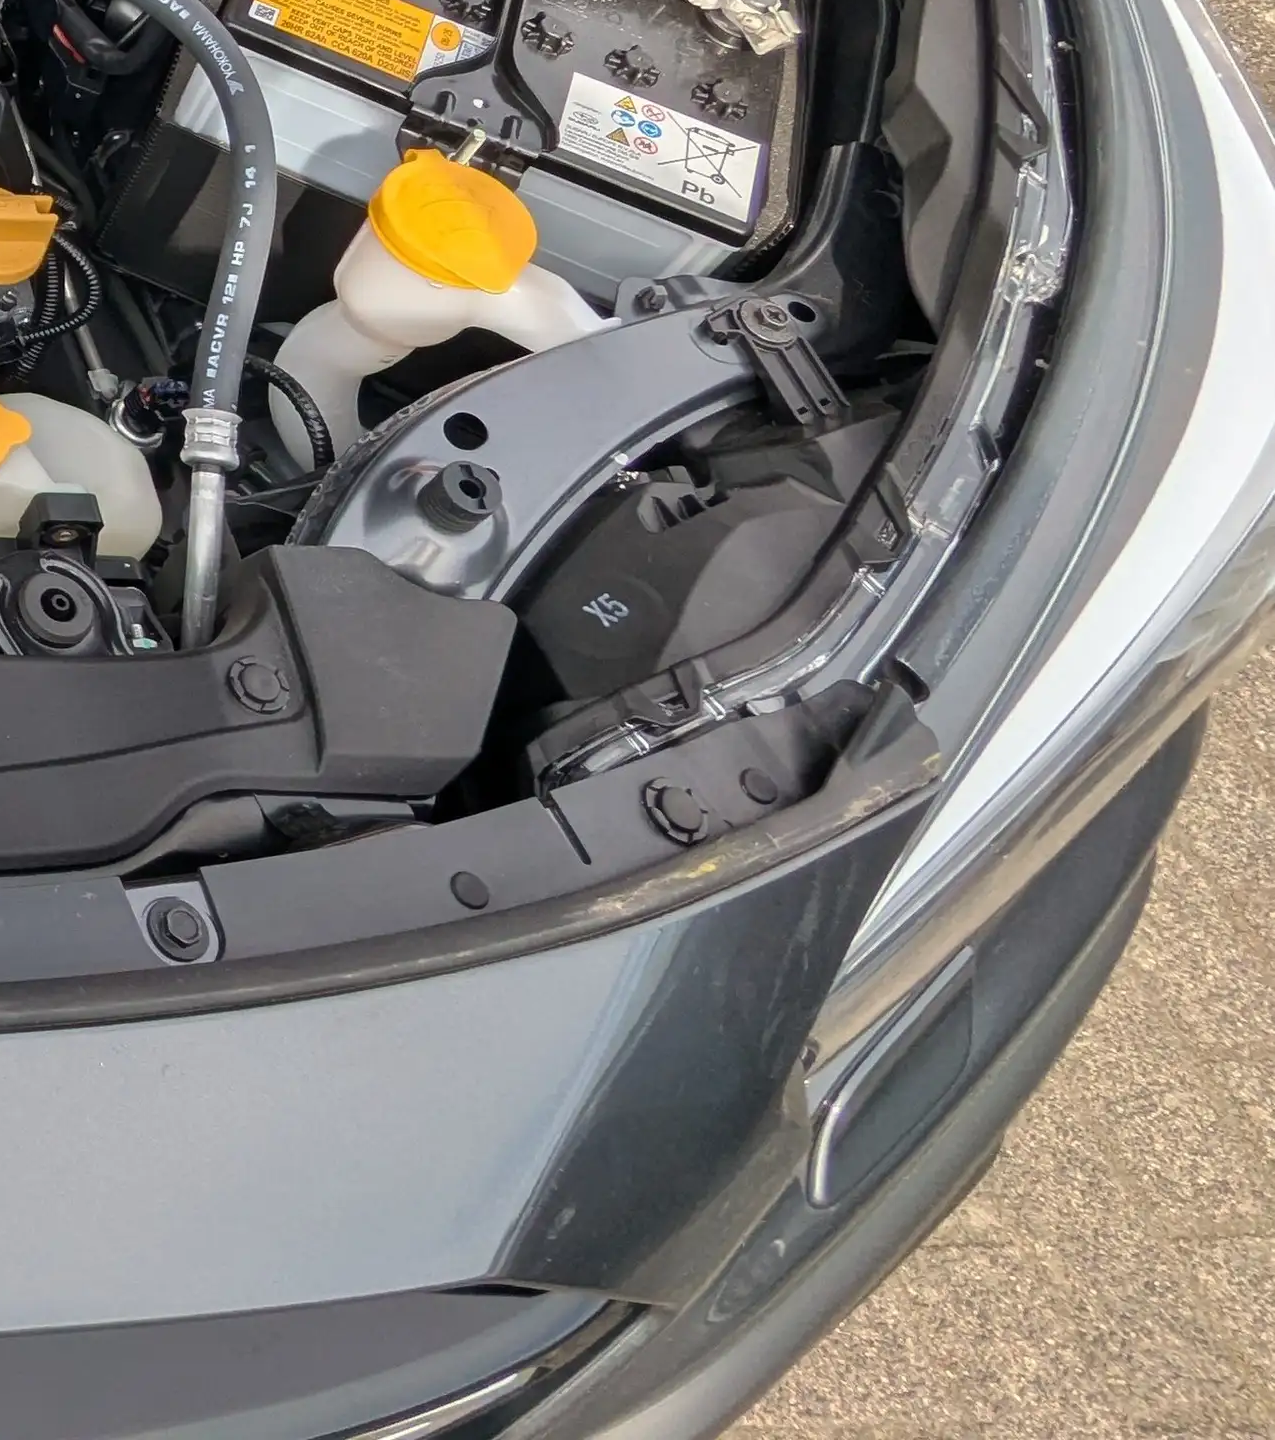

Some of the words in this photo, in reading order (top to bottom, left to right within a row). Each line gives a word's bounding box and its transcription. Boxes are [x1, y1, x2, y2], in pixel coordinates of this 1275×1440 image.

[287, 12, 309, 26] KEEP
[308, 21, 325, 33] OUT
[337, 33, 364, 49] REACH
[290, 7, 311, 20] KEEP
[310, 15, 331, 29] VENT
[331, 23, 353, 38] CAPS
[375, 41, 393, 54] AND
[393, 48, 418, 64] LEVEL
[345, 10, 375, 28] SEVERE
[375, 22, 403, 38] BURNS
[192, 20, 237, 80] YOKOHAMA
[330, 38, 352, 54] CCA
[244, 166, 257, 188] 14
[680, 178, 716, 207] Pb
[238, 203, 253, 229] 7J
[231, 241, 245, 266] HP
[581, 592, 630, 628] X5
